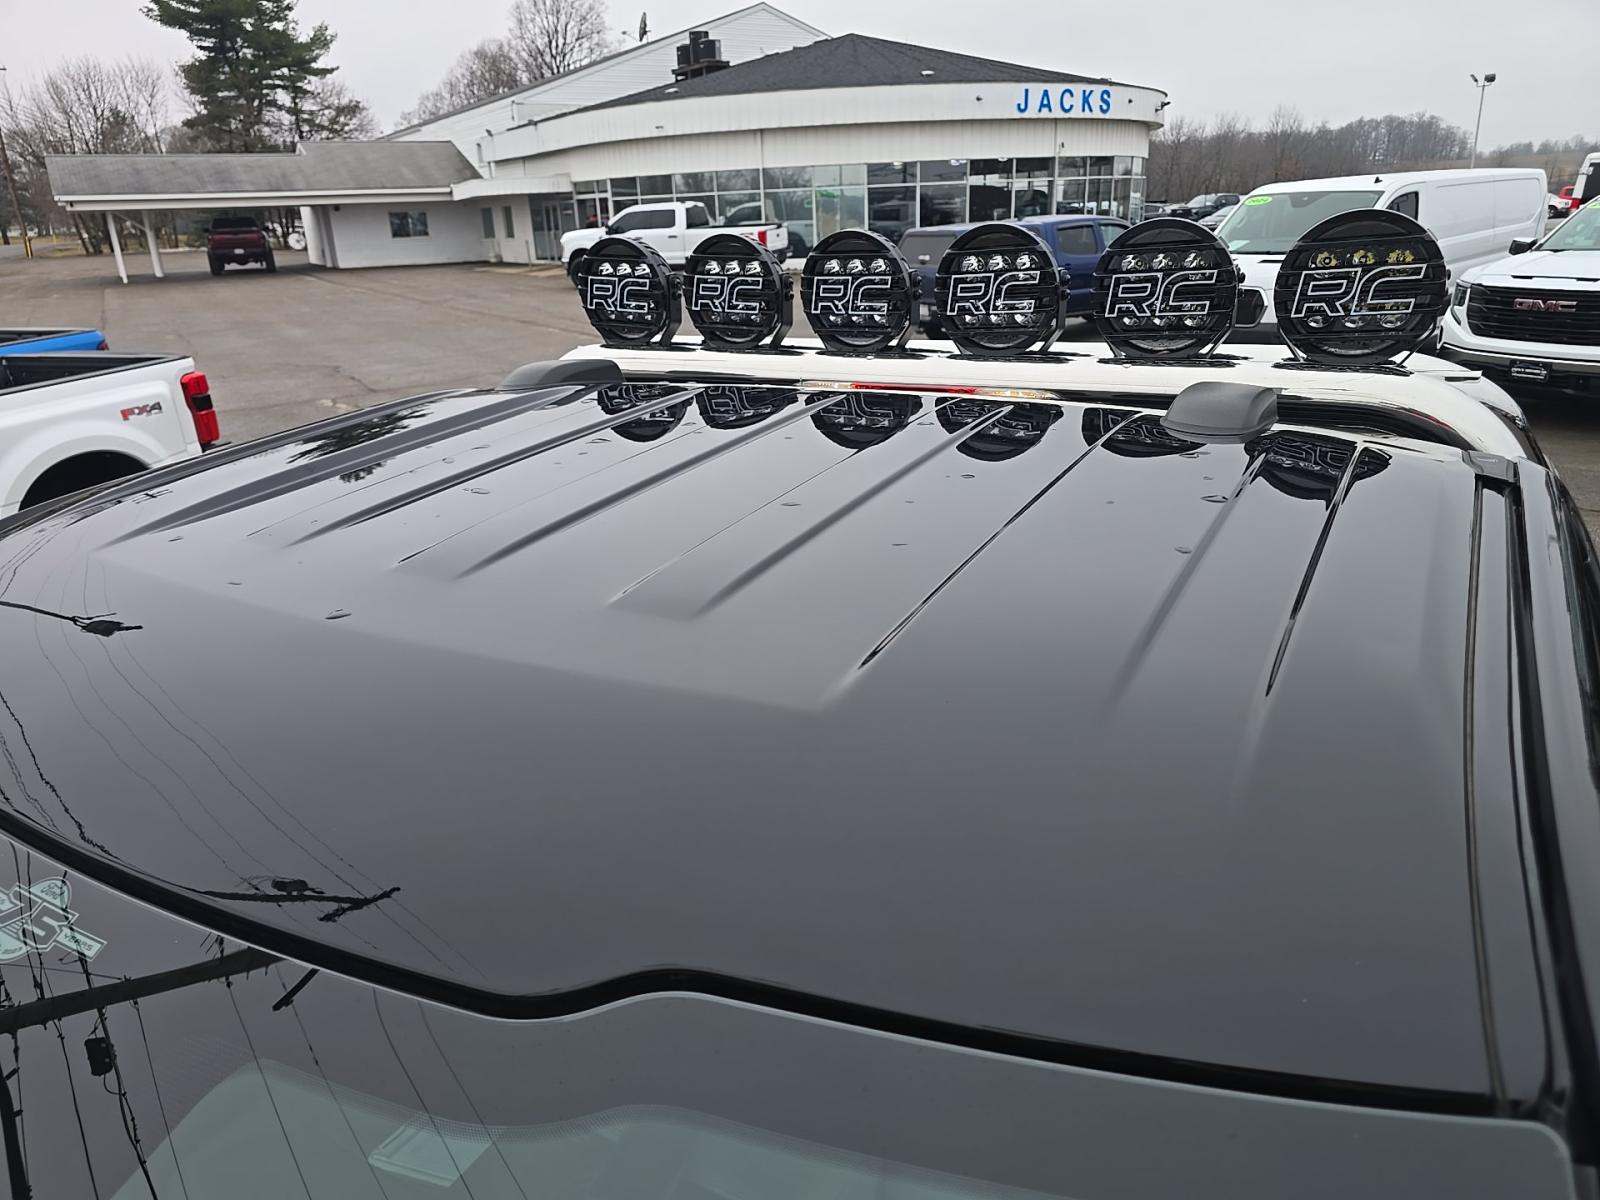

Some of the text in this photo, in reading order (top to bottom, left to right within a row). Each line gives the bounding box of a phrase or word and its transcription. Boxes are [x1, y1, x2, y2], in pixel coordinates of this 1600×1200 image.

[1017, 88, 1111, 114] JACKS
[587, 276, 649, 313] RC
[692, 275, 763, 313] RC
[811, 276, 891, 315] RC
[947, 270, 1040, 317] RC
[1105, 270, 1218, 318] RC
[1292, 264, 1427, 318] RC
[1513, 298, 1578, 313] GMC
